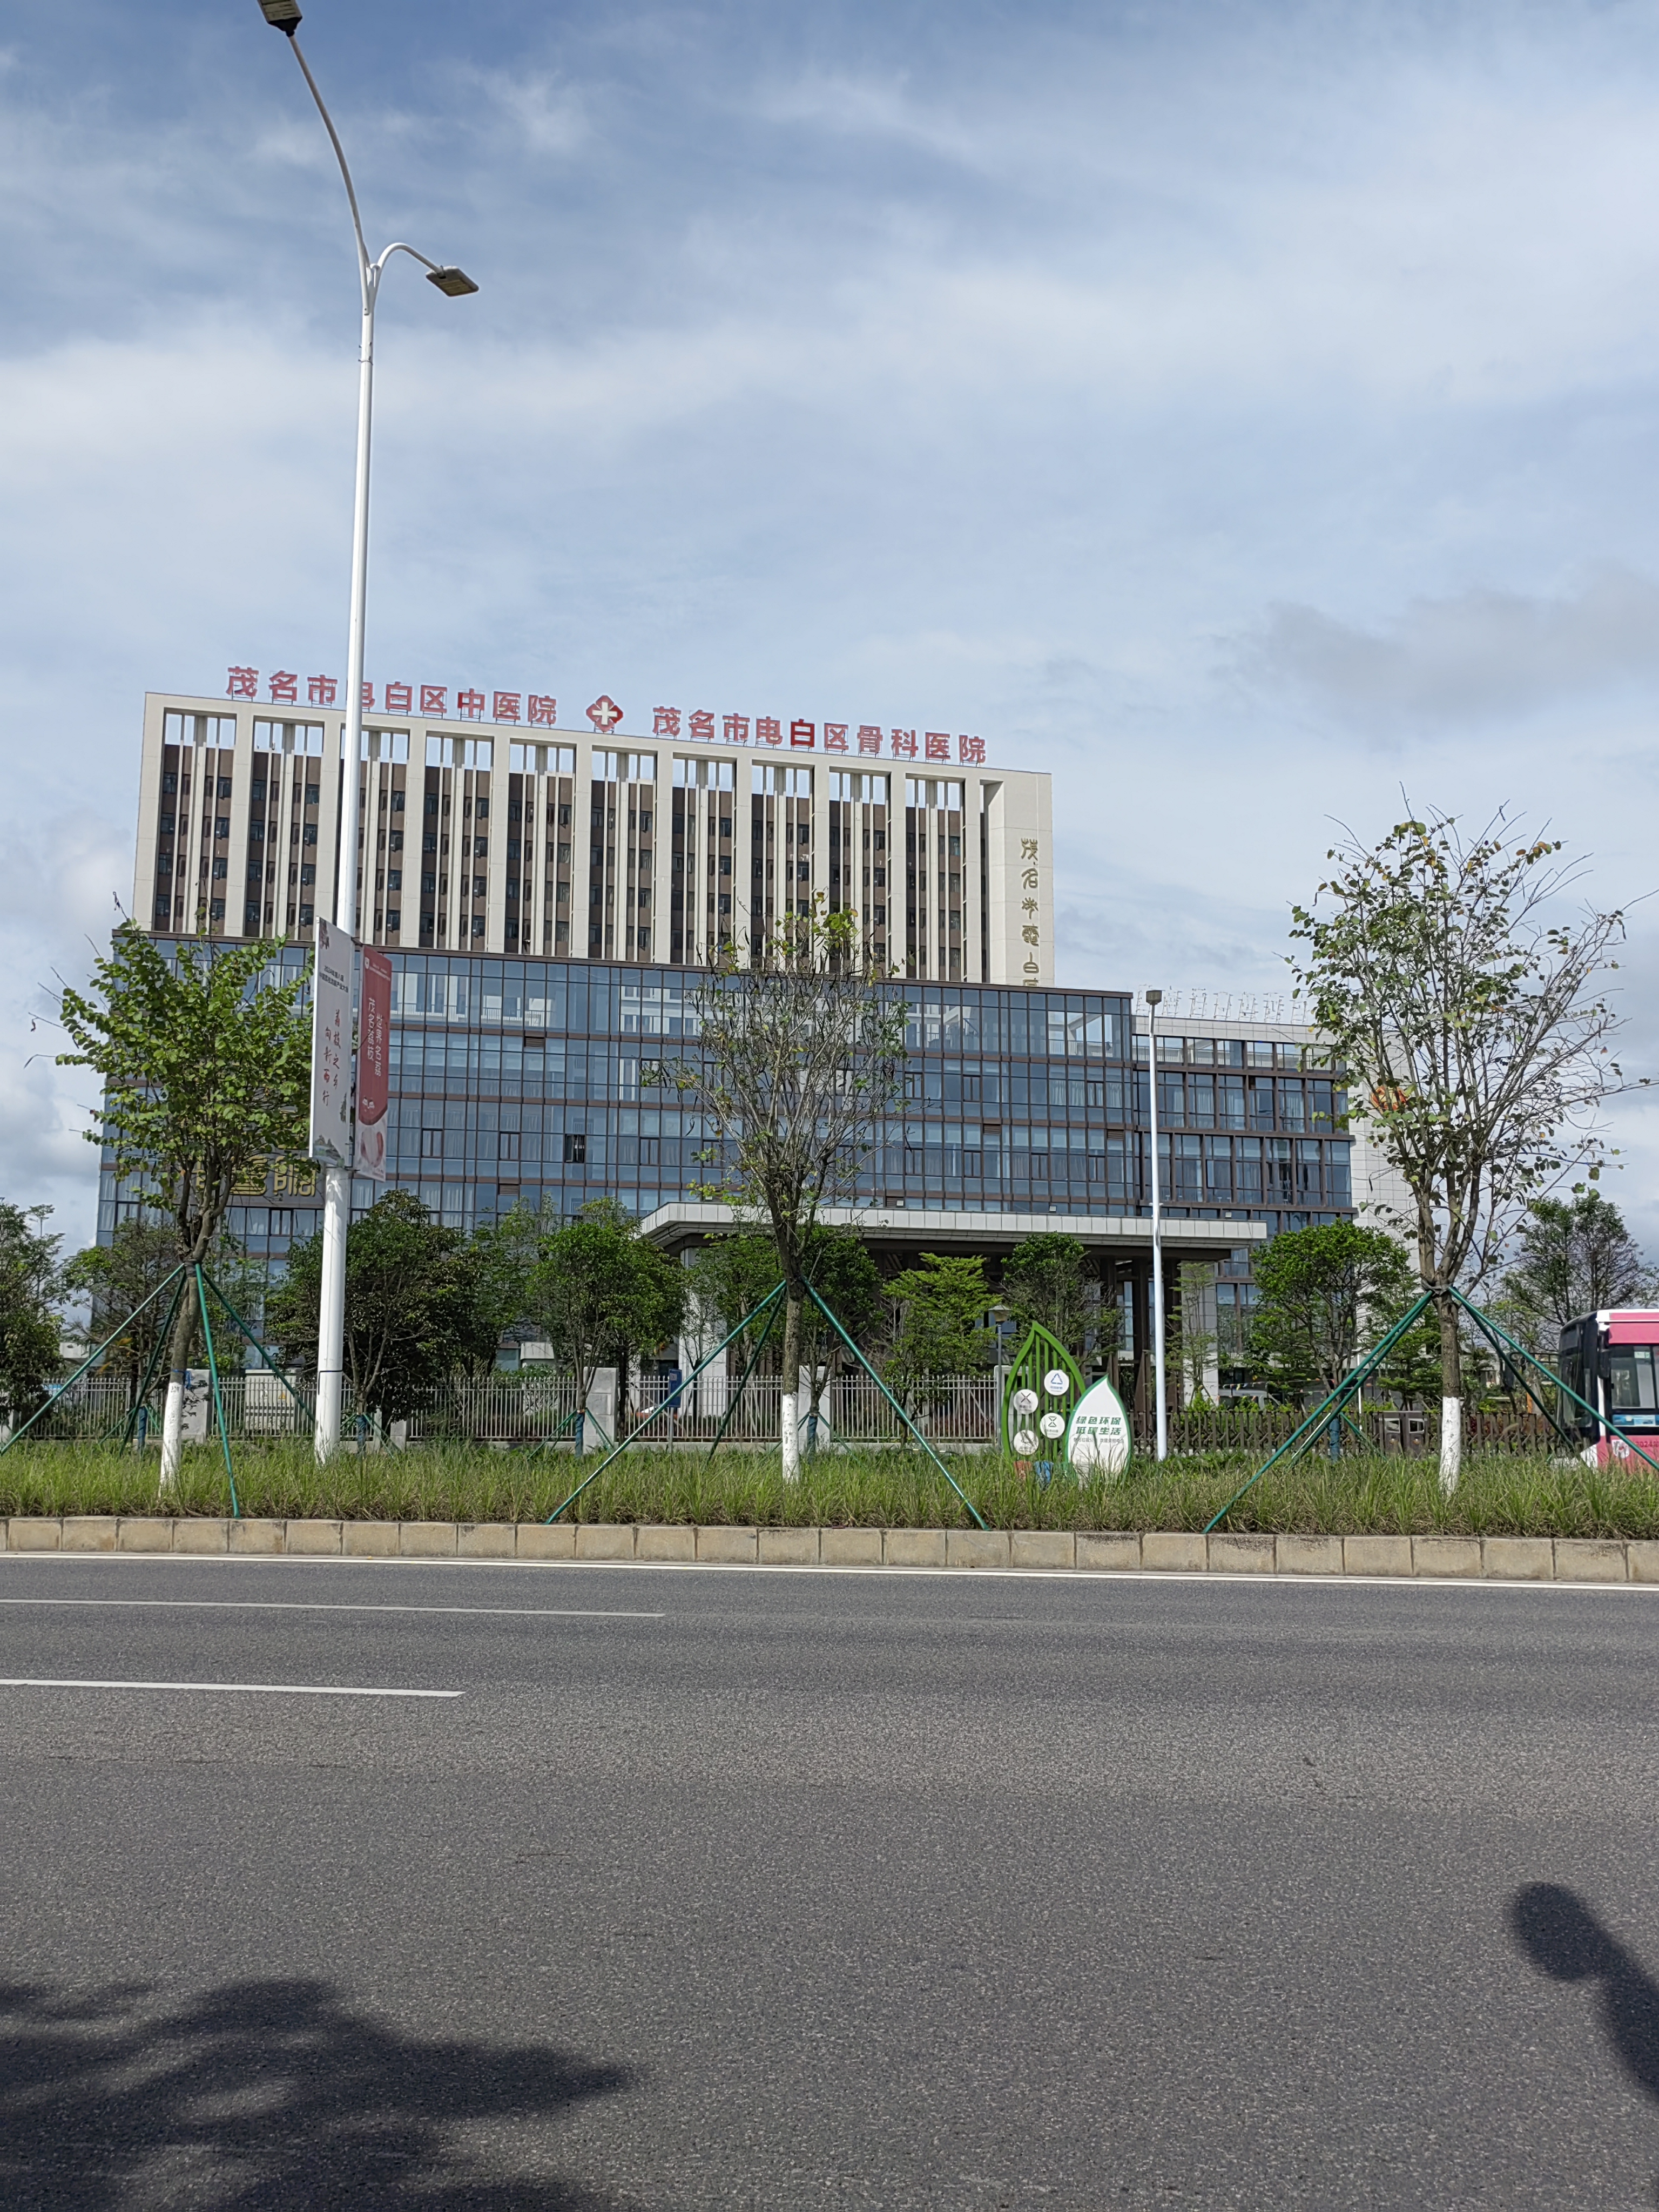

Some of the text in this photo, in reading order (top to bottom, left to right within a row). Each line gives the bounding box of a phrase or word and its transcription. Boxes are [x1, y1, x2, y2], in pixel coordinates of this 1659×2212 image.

[652, 706, 986, 763] 茂名市电白区骨科医院
[1076, 1416, 1121, 1425] 绿色环保
